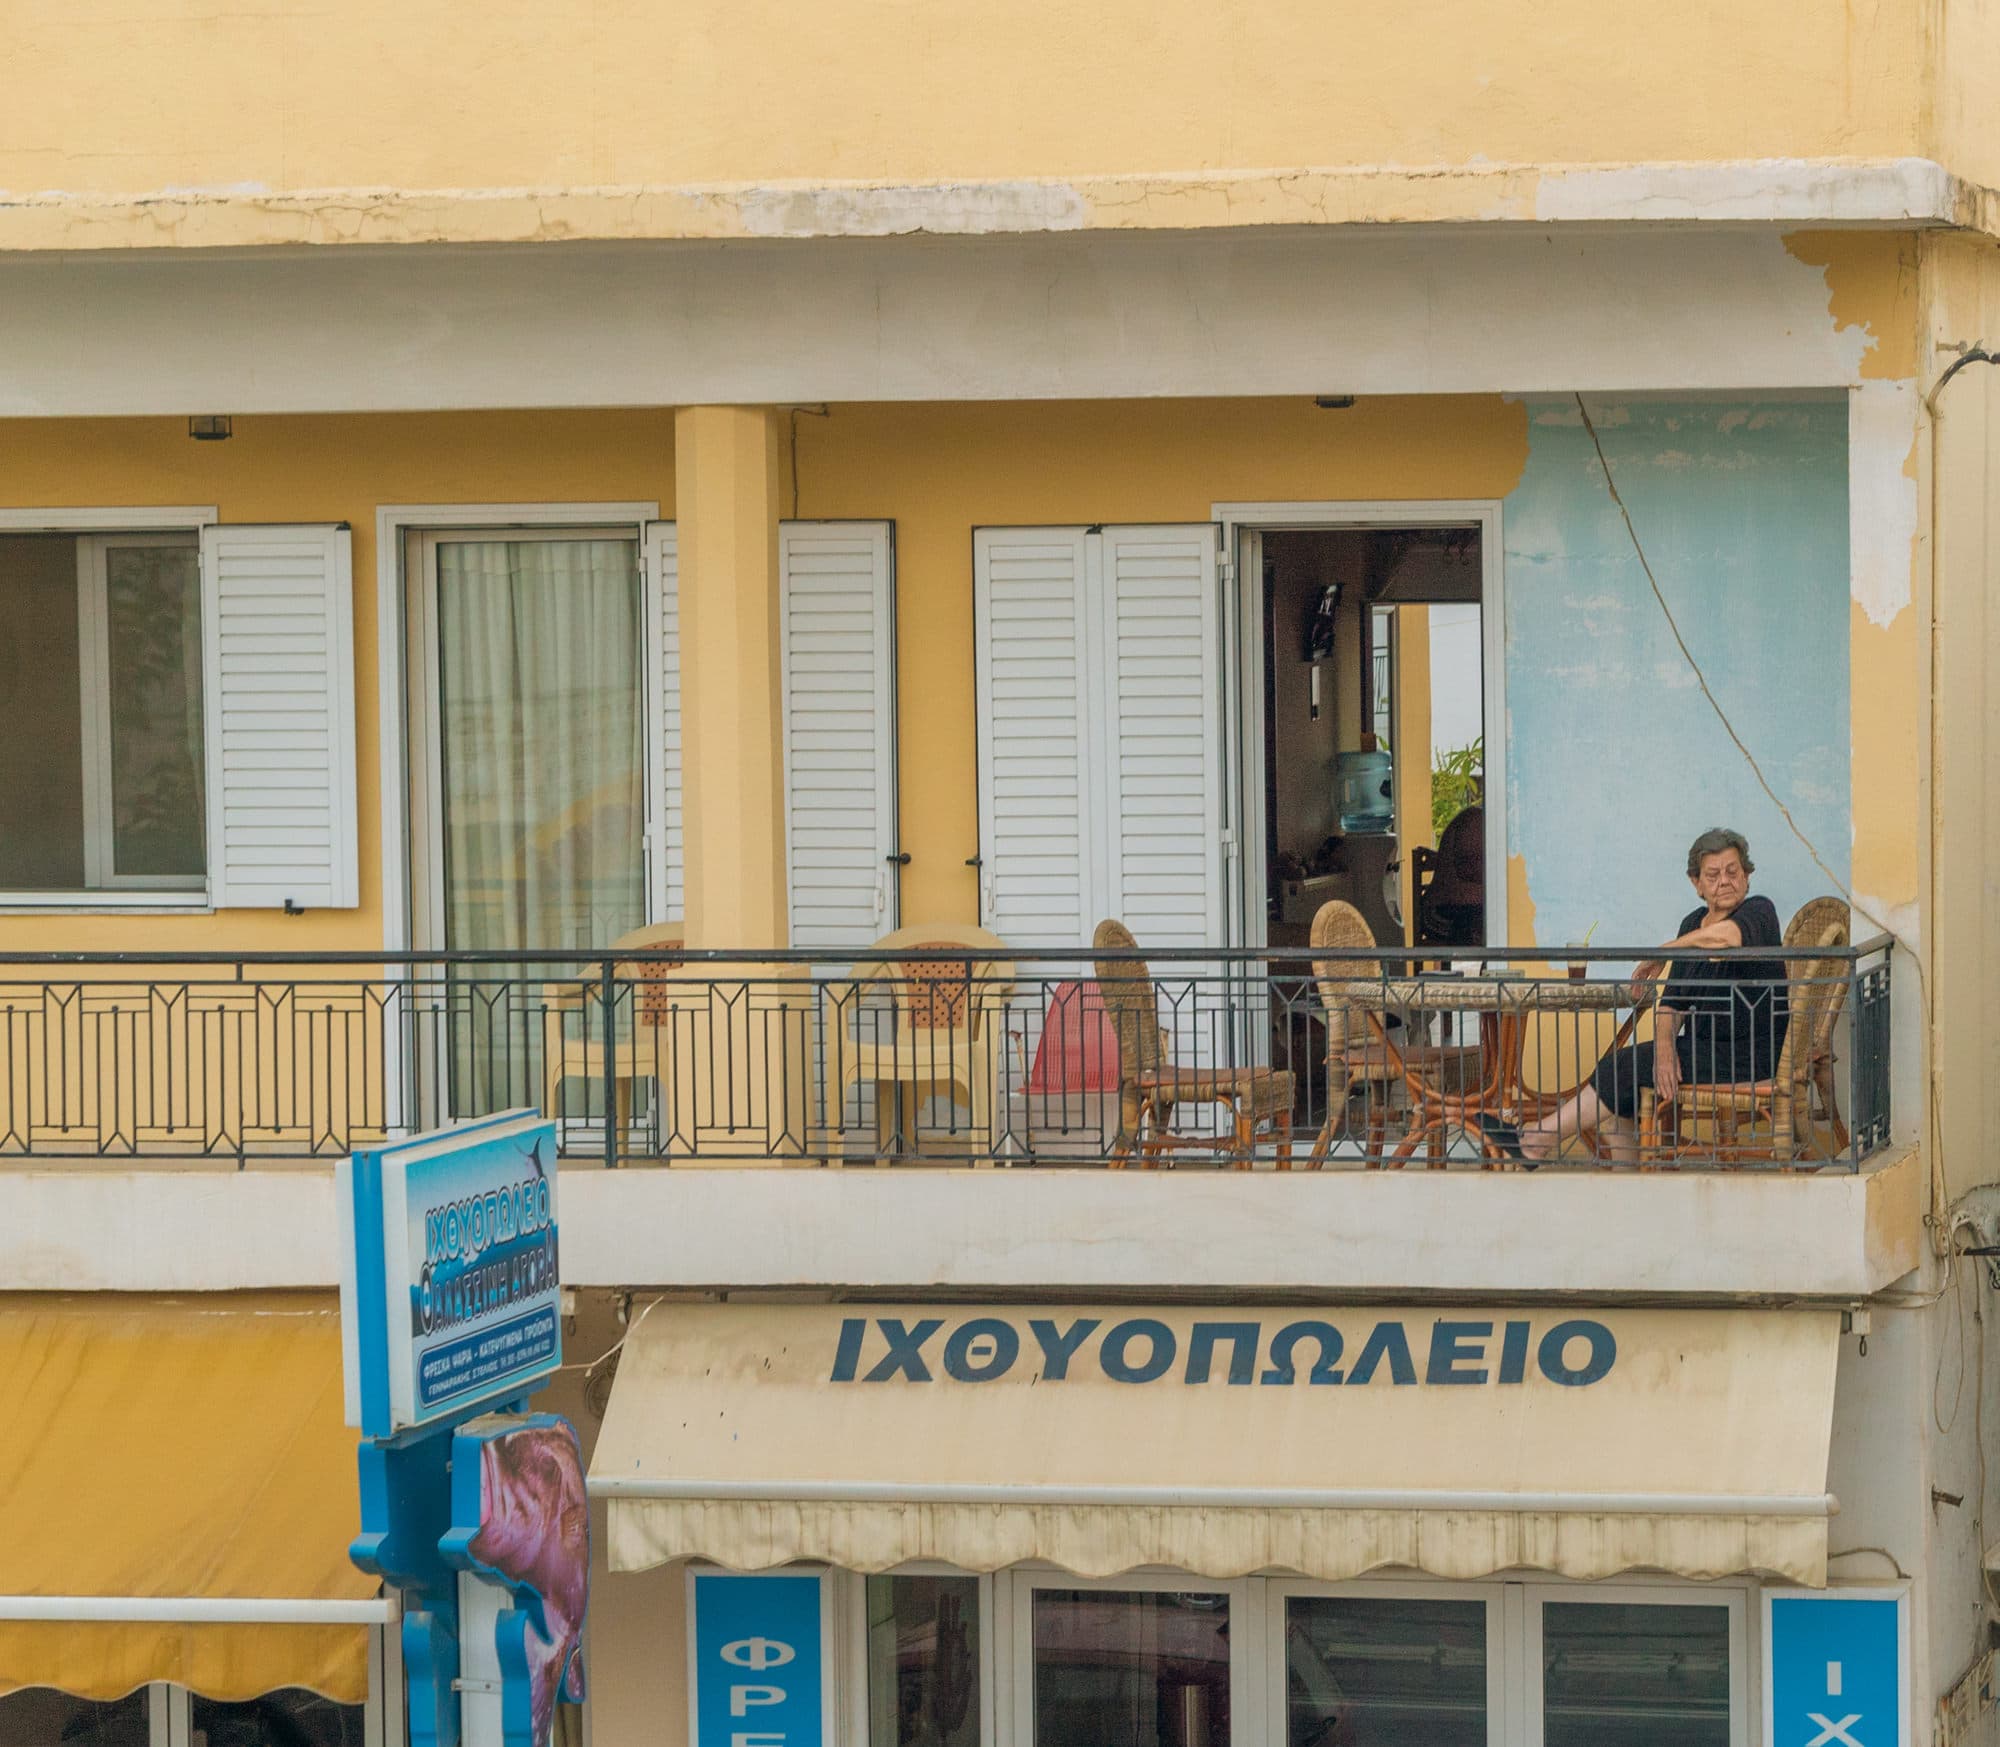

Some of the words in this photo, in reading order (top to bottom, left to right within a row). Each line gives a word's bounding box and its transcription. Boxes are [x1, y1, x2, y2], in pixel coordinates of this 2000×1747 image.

[425, 1176, 549, 1265] ΙΧΘΥΟΠΩΛΕΙΟ
[420, 1261, 508, 1336] ΘΑΛΑΣΣΙΝΗ
[830, 1319, 1617, 1386] ΙΧΘΥΟΠΩΛΕΙΟ
[1805, 1661, 1865, 1747] ΙΧ
